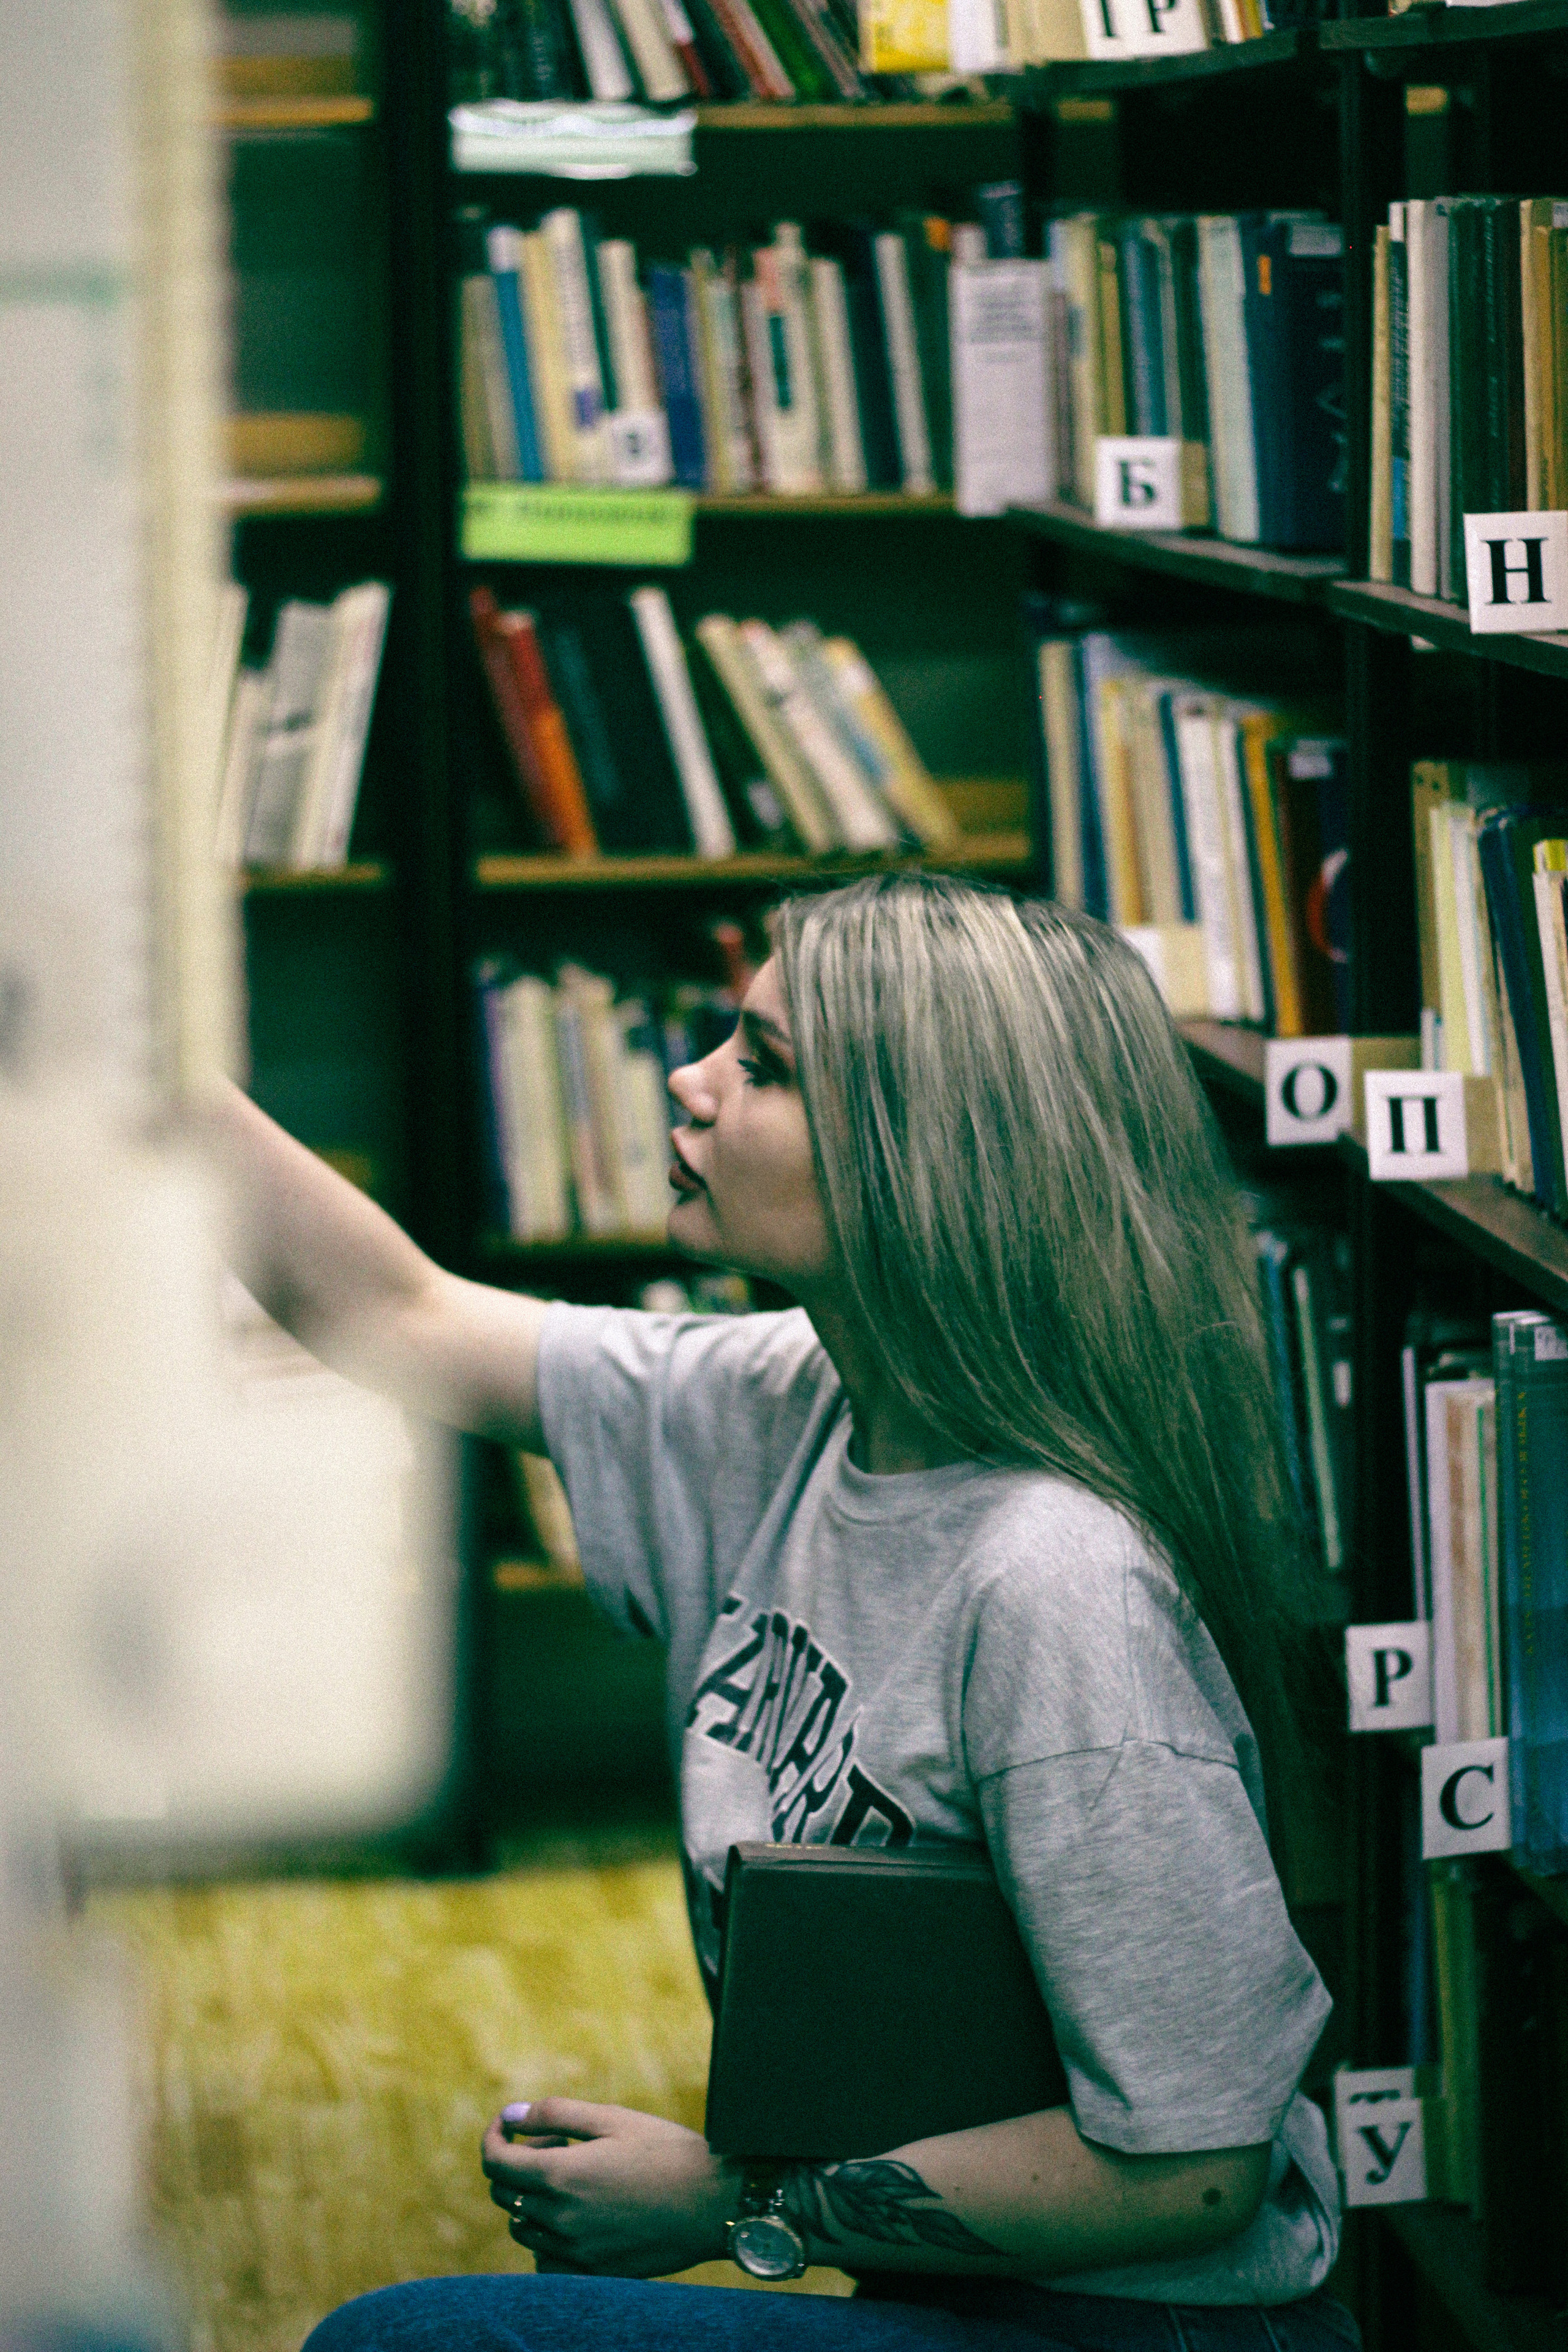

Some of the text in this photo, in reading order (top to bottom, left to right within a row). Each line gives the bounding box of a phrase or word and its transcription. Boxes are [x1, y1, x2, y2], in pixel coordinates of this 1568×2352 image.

[1116, 459, 1159, 509] Б
[1482, 537, 1551, 606] Н
[1280, 1062, 1339, 1121] О
[1386, 1095, 1442, 1155] П
[1371, 1648, 1414, 1709] Р
[1439, 1765, 1494, 1832] С
[1356, 2120, 1414, 2185] У
